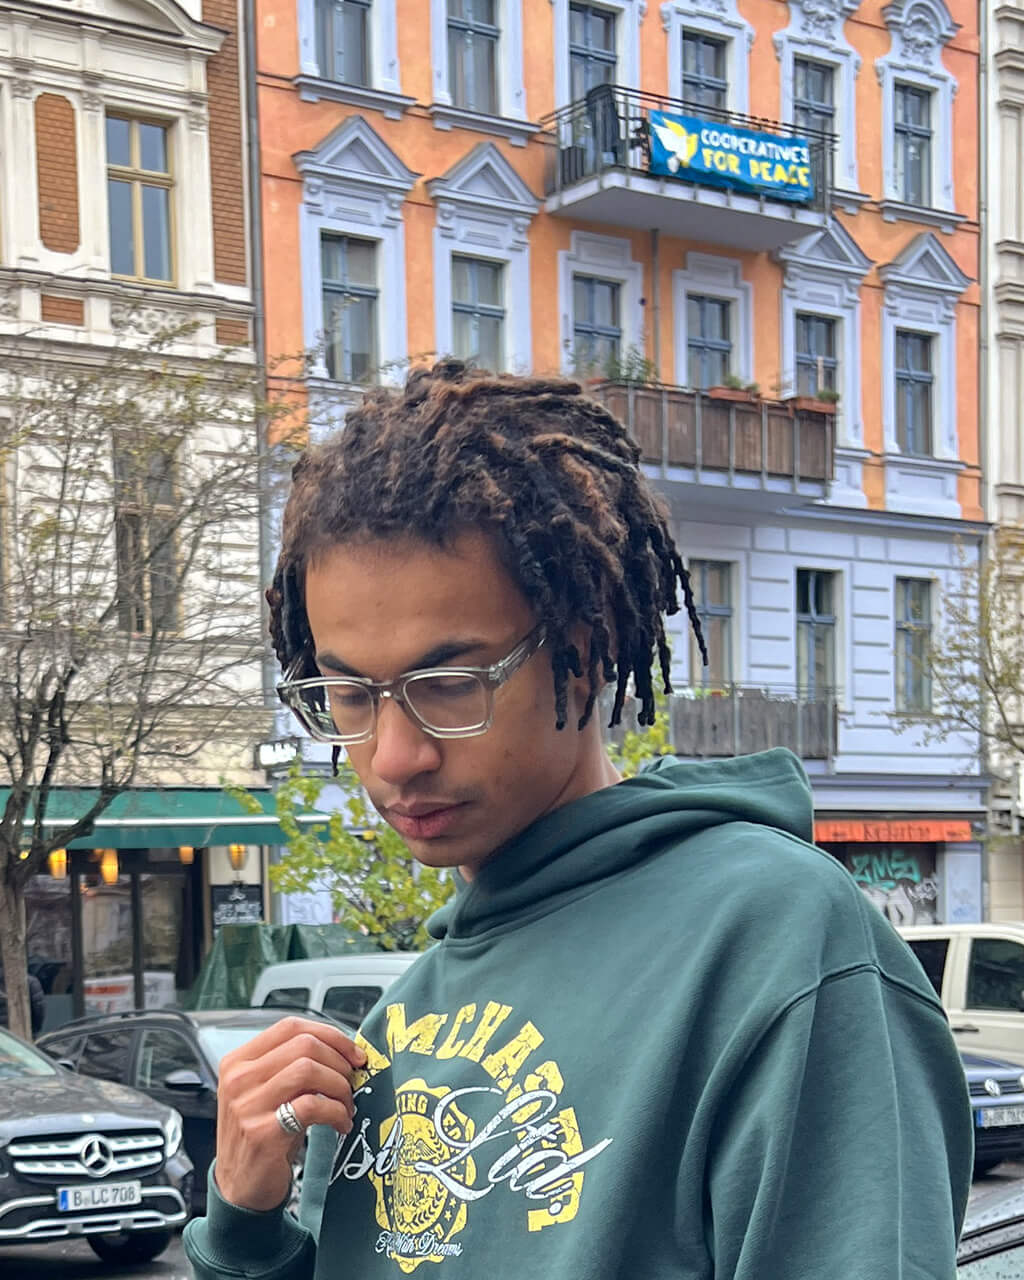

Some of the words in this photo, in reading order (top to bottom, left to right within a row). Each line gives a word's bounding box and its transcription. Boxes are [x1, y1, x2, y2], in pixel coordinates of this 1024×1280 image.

[700, 127, 810, 165] COOPERATIVES
[701, 147, 741, 176] FOR
[748, 158, 810, 188] PEACE
[73, 1190, 83, 1207] B
[91, 1188, 110, 1205] LC
[416, 1230, 464, 1257] Dreams
